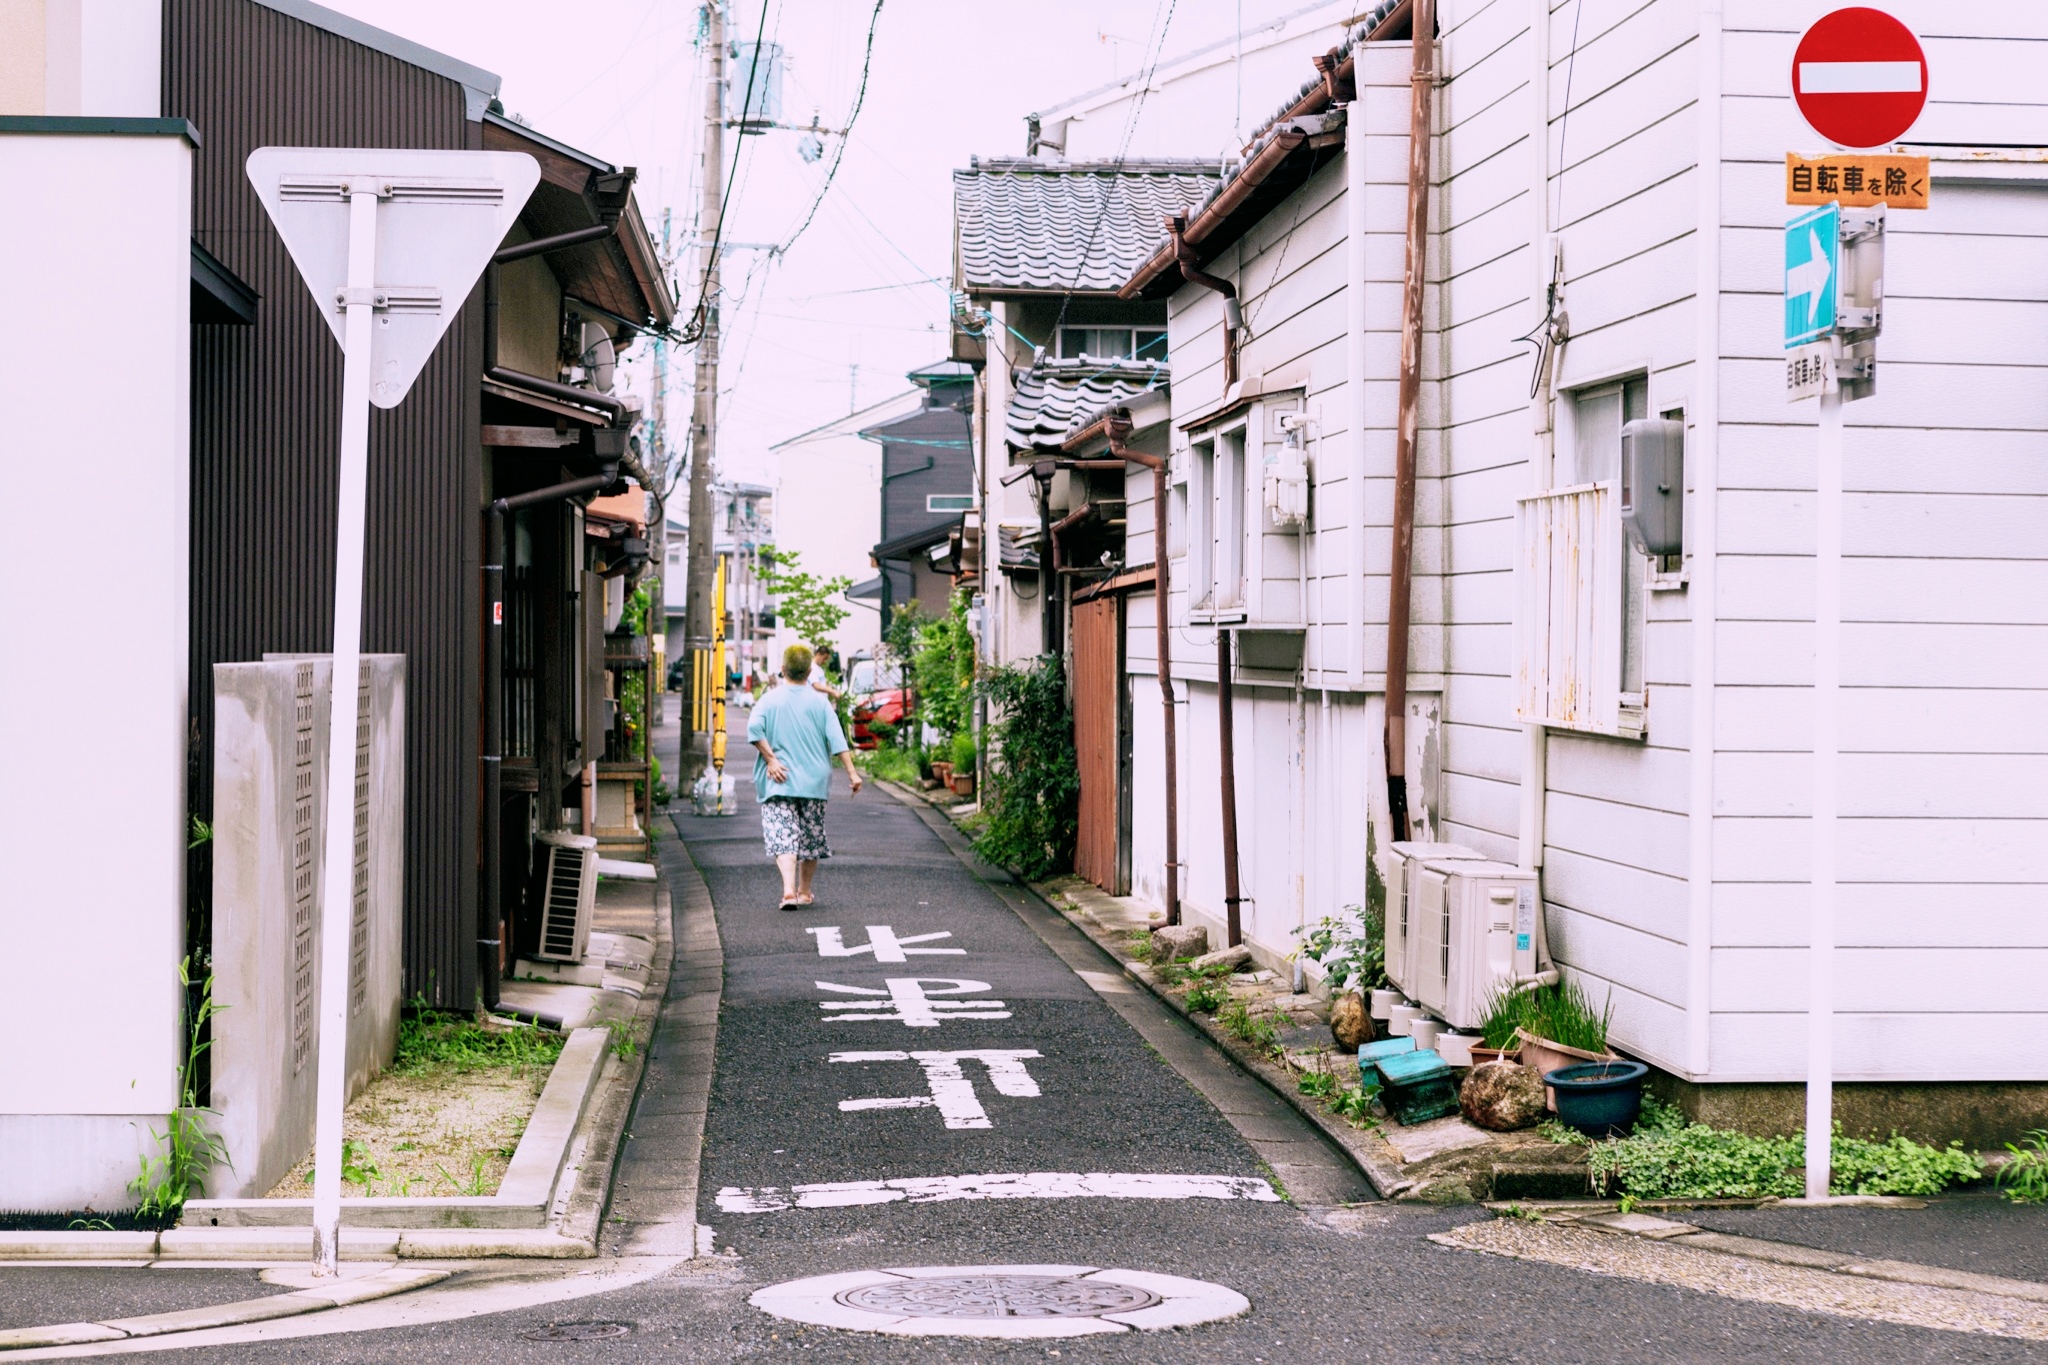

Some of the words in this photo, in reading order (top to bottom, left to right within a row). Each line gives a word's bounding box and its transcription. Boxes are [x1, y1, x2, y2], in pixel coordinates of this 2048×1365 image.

[1793, 164, 1923, 197] 自転車を除く
